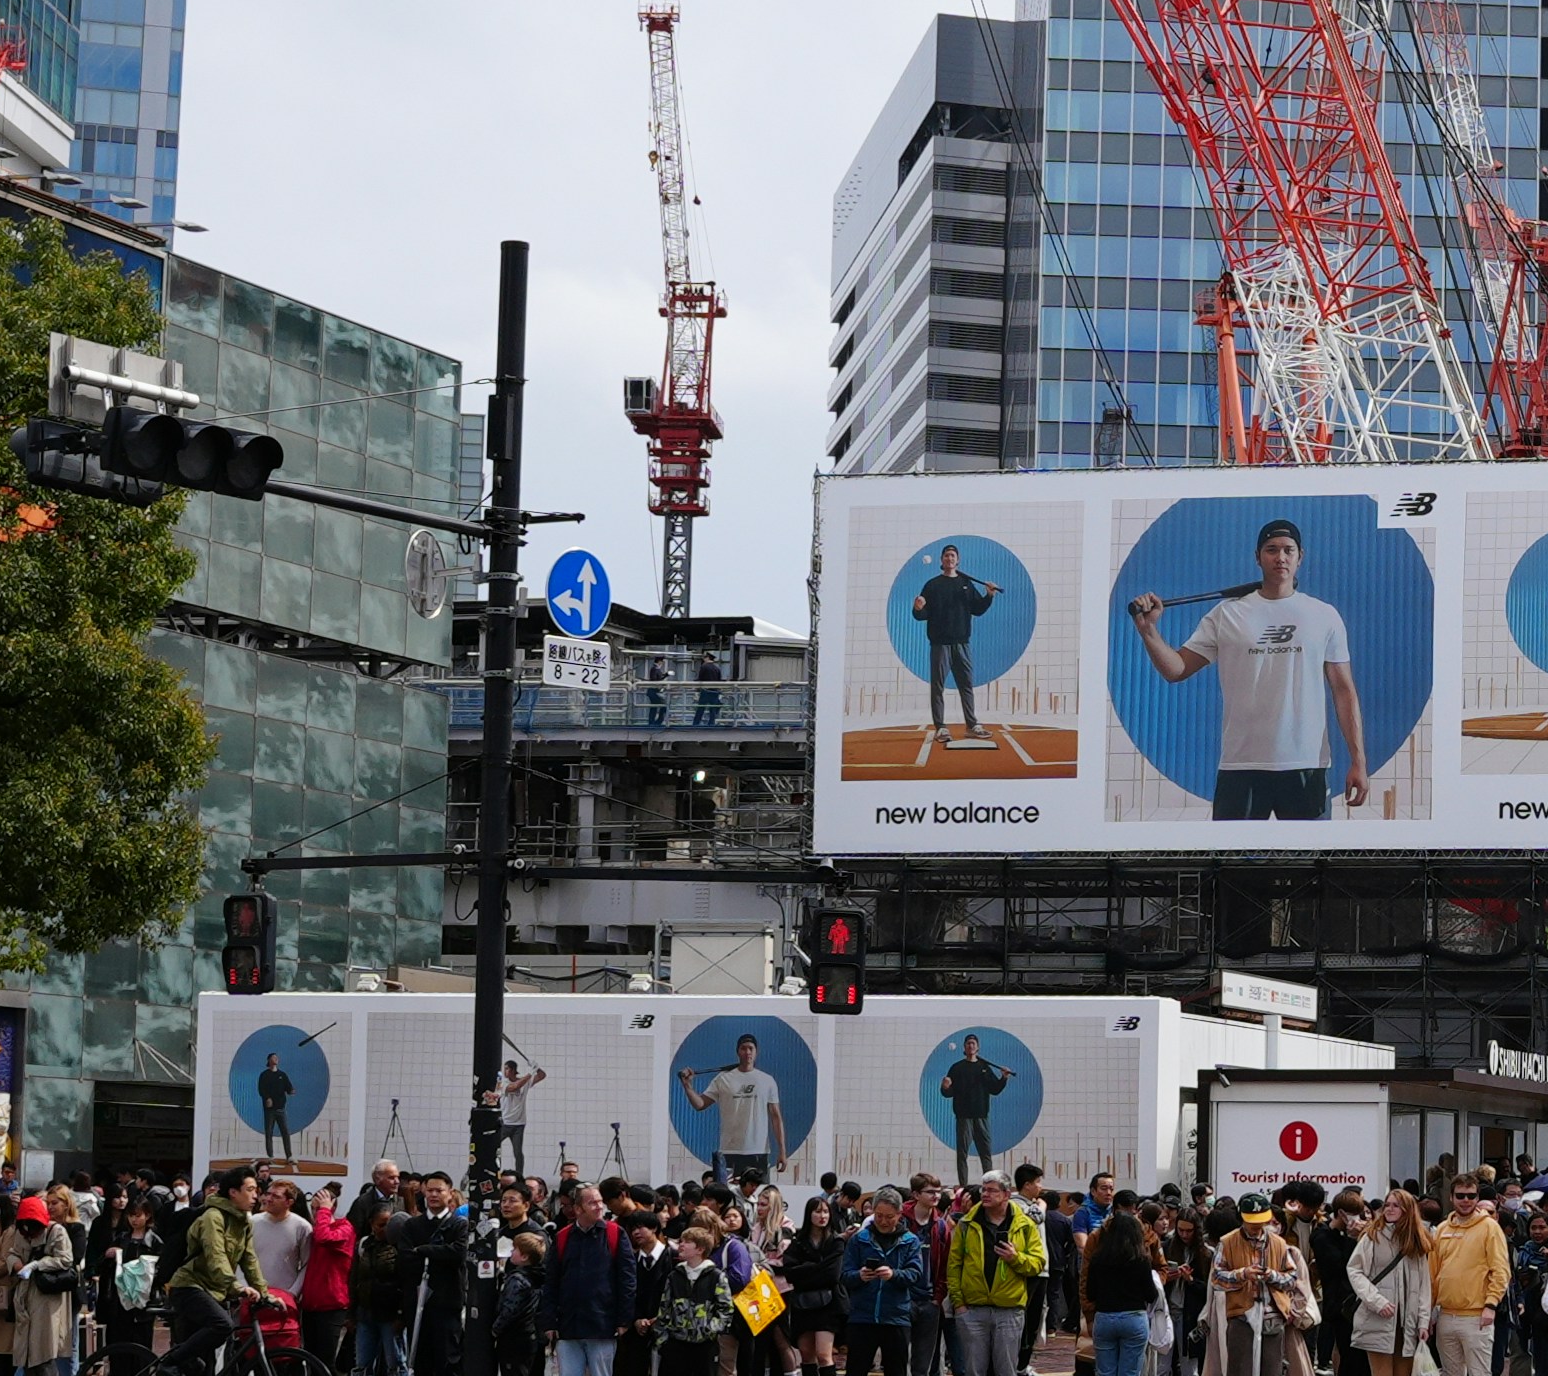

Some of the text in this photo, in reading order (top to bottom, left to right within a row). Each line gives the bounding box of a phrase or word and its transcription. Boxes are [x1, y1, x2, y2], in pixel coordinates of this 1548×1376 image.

[876, 801, 1040, 825] new balance
[1498, 1047, 1521, 1080] SHIBU
[1522, 1052, 1546, 1084] HACHI
[1231, 1171, 1366, 1184] Tourist Information
